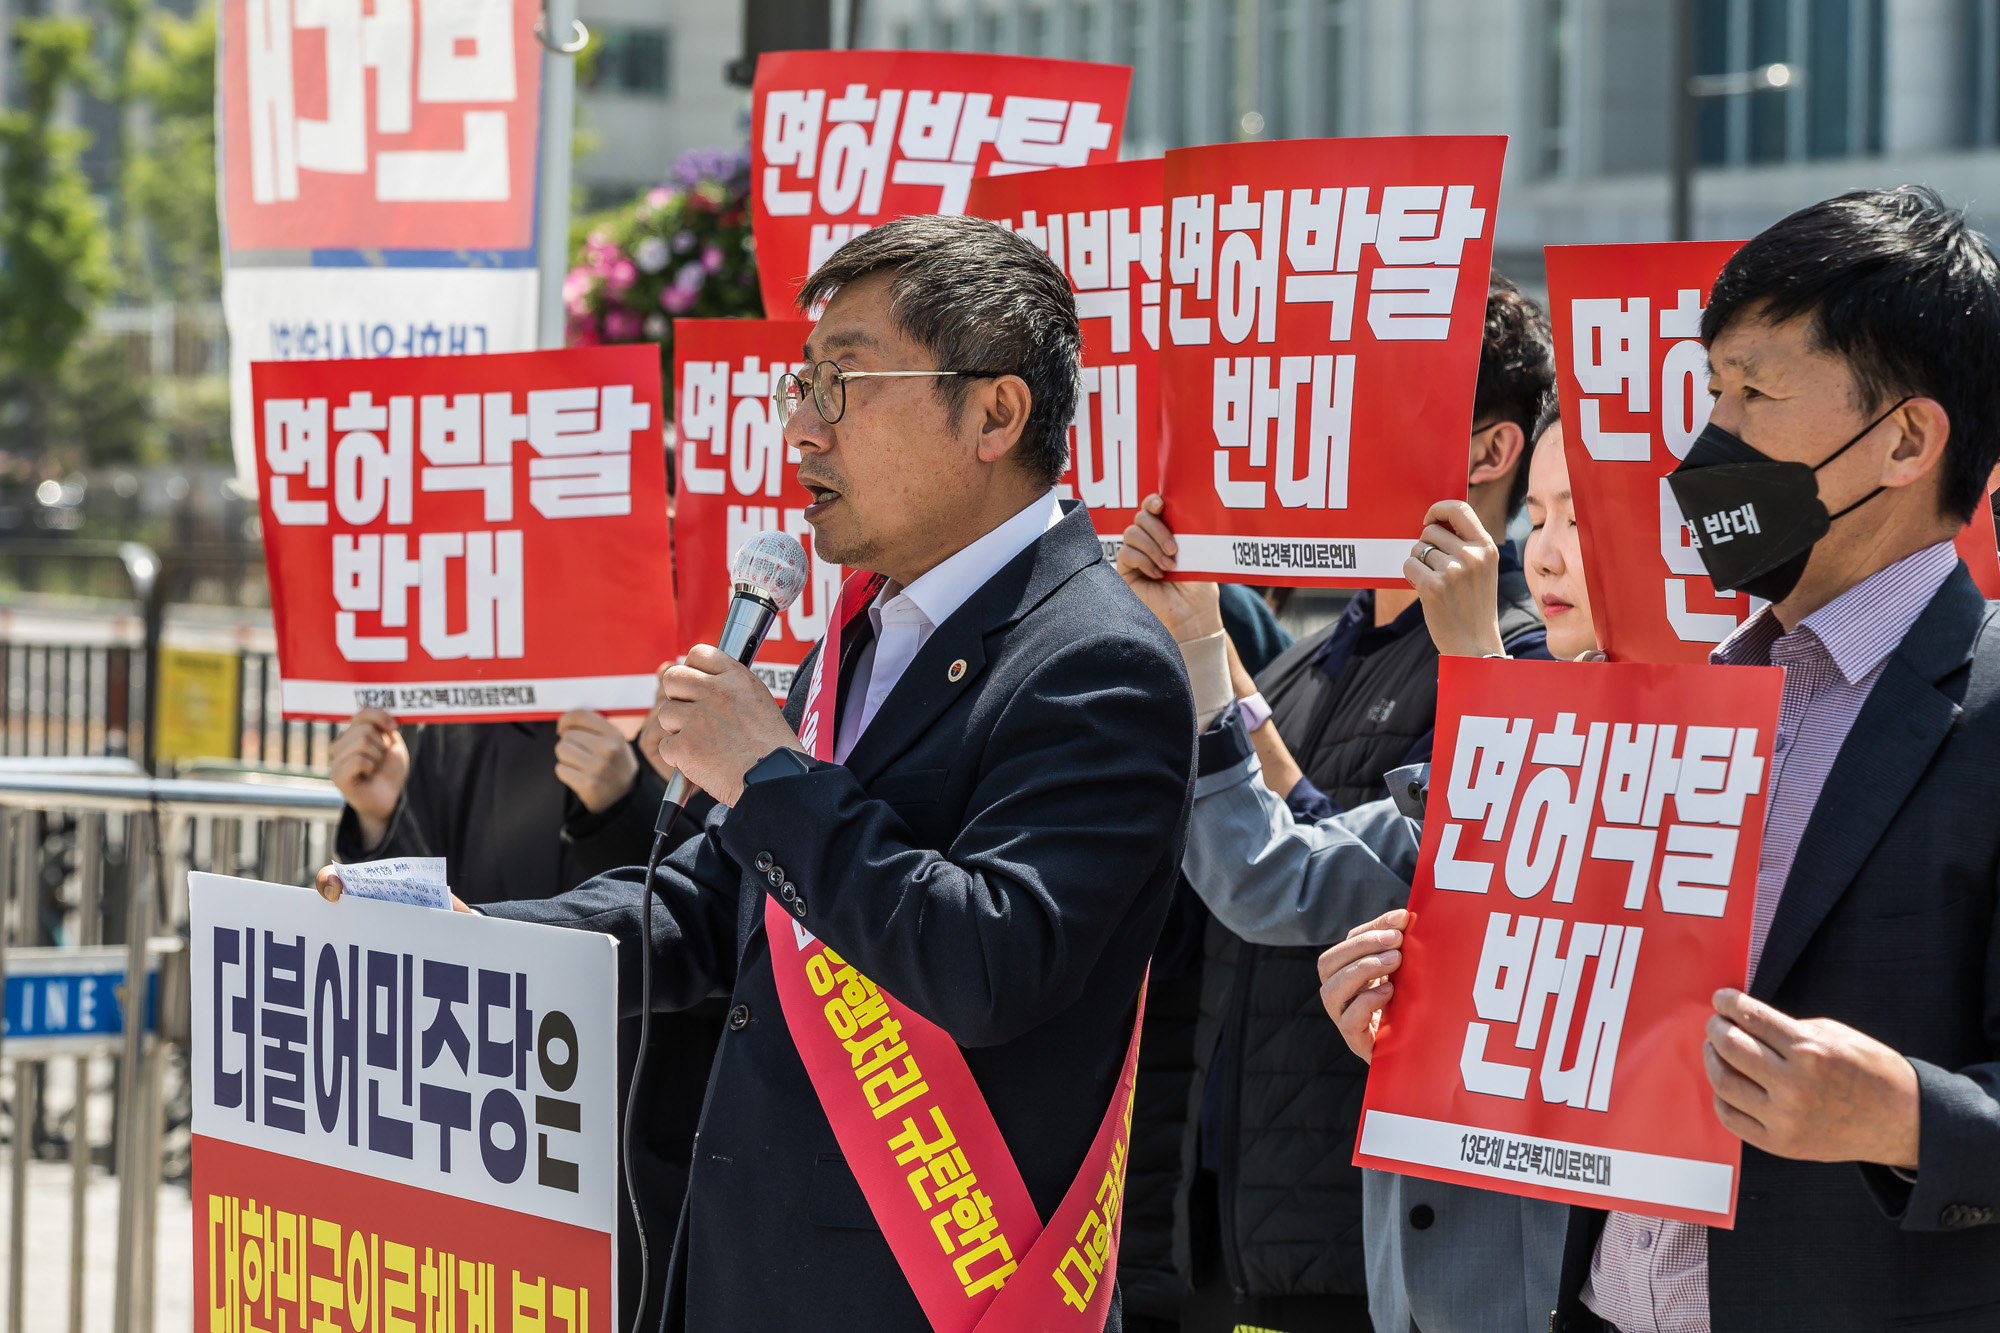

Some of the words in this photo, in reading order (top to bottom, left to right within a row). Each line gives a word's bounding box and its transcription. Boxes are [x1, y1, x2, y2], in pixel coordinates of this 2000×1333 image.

[1169, 185, 1486, 346] 면허박탈
[264, 385, 651, 526] 면허박탈
[681, 356, 803, 498] 면허
[1213, 355, 1357, 510] 반대
[1233, 542, 1260, 567] 13단체
[1261, 543, 1357, 569] 보건복지의료연대
[1702, 503, 1761, 545] 반대
[332, 530, 526, 662] 반대
[400, 685, 536, 709] 보건복지의료연대
[1434, 712, 1765, 918] 면허박탈
[0, 977, 97, 1034] INE
[213, 926, 581, 1194] 더불어민주당은
[1460, 911, 1644, 1112] 반대
[887, 1105, 1019, 1299] 규탄한다
[1460, 1133, 1505, 1168] 13단체
[1503, 1140, 1612, 1186] 보건복지의료연대
